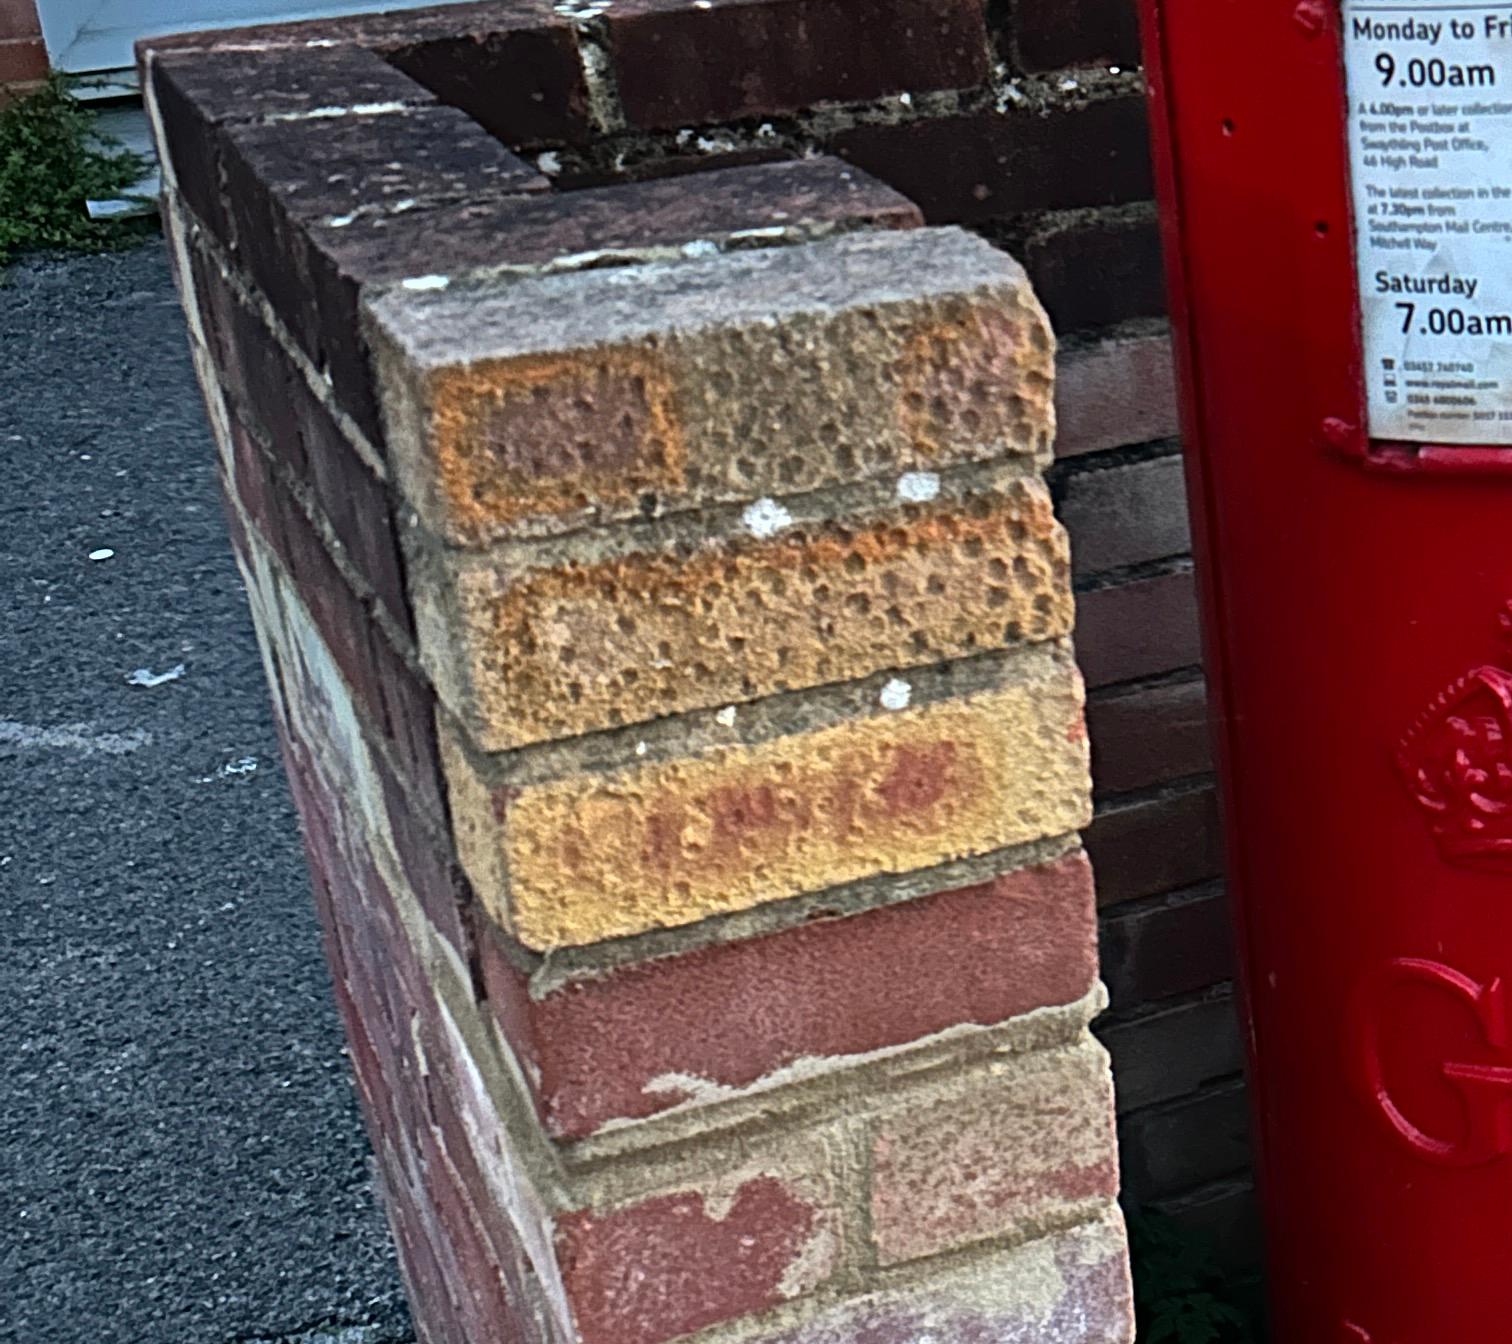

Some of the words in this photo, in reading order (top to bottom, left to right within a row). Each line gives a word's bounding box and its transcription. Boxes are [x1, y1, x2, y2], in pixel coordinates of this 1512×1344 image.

[1353, 16, 1442, 46] Monday
[1450, 18, 1475, 40] to
[1374, 51, 1496, 89] 9.00am
[1366, 183, 1386, 198] The
[1421, 185, 1476, 200] collection
[1375, 270, 1479, 299] Saturday
